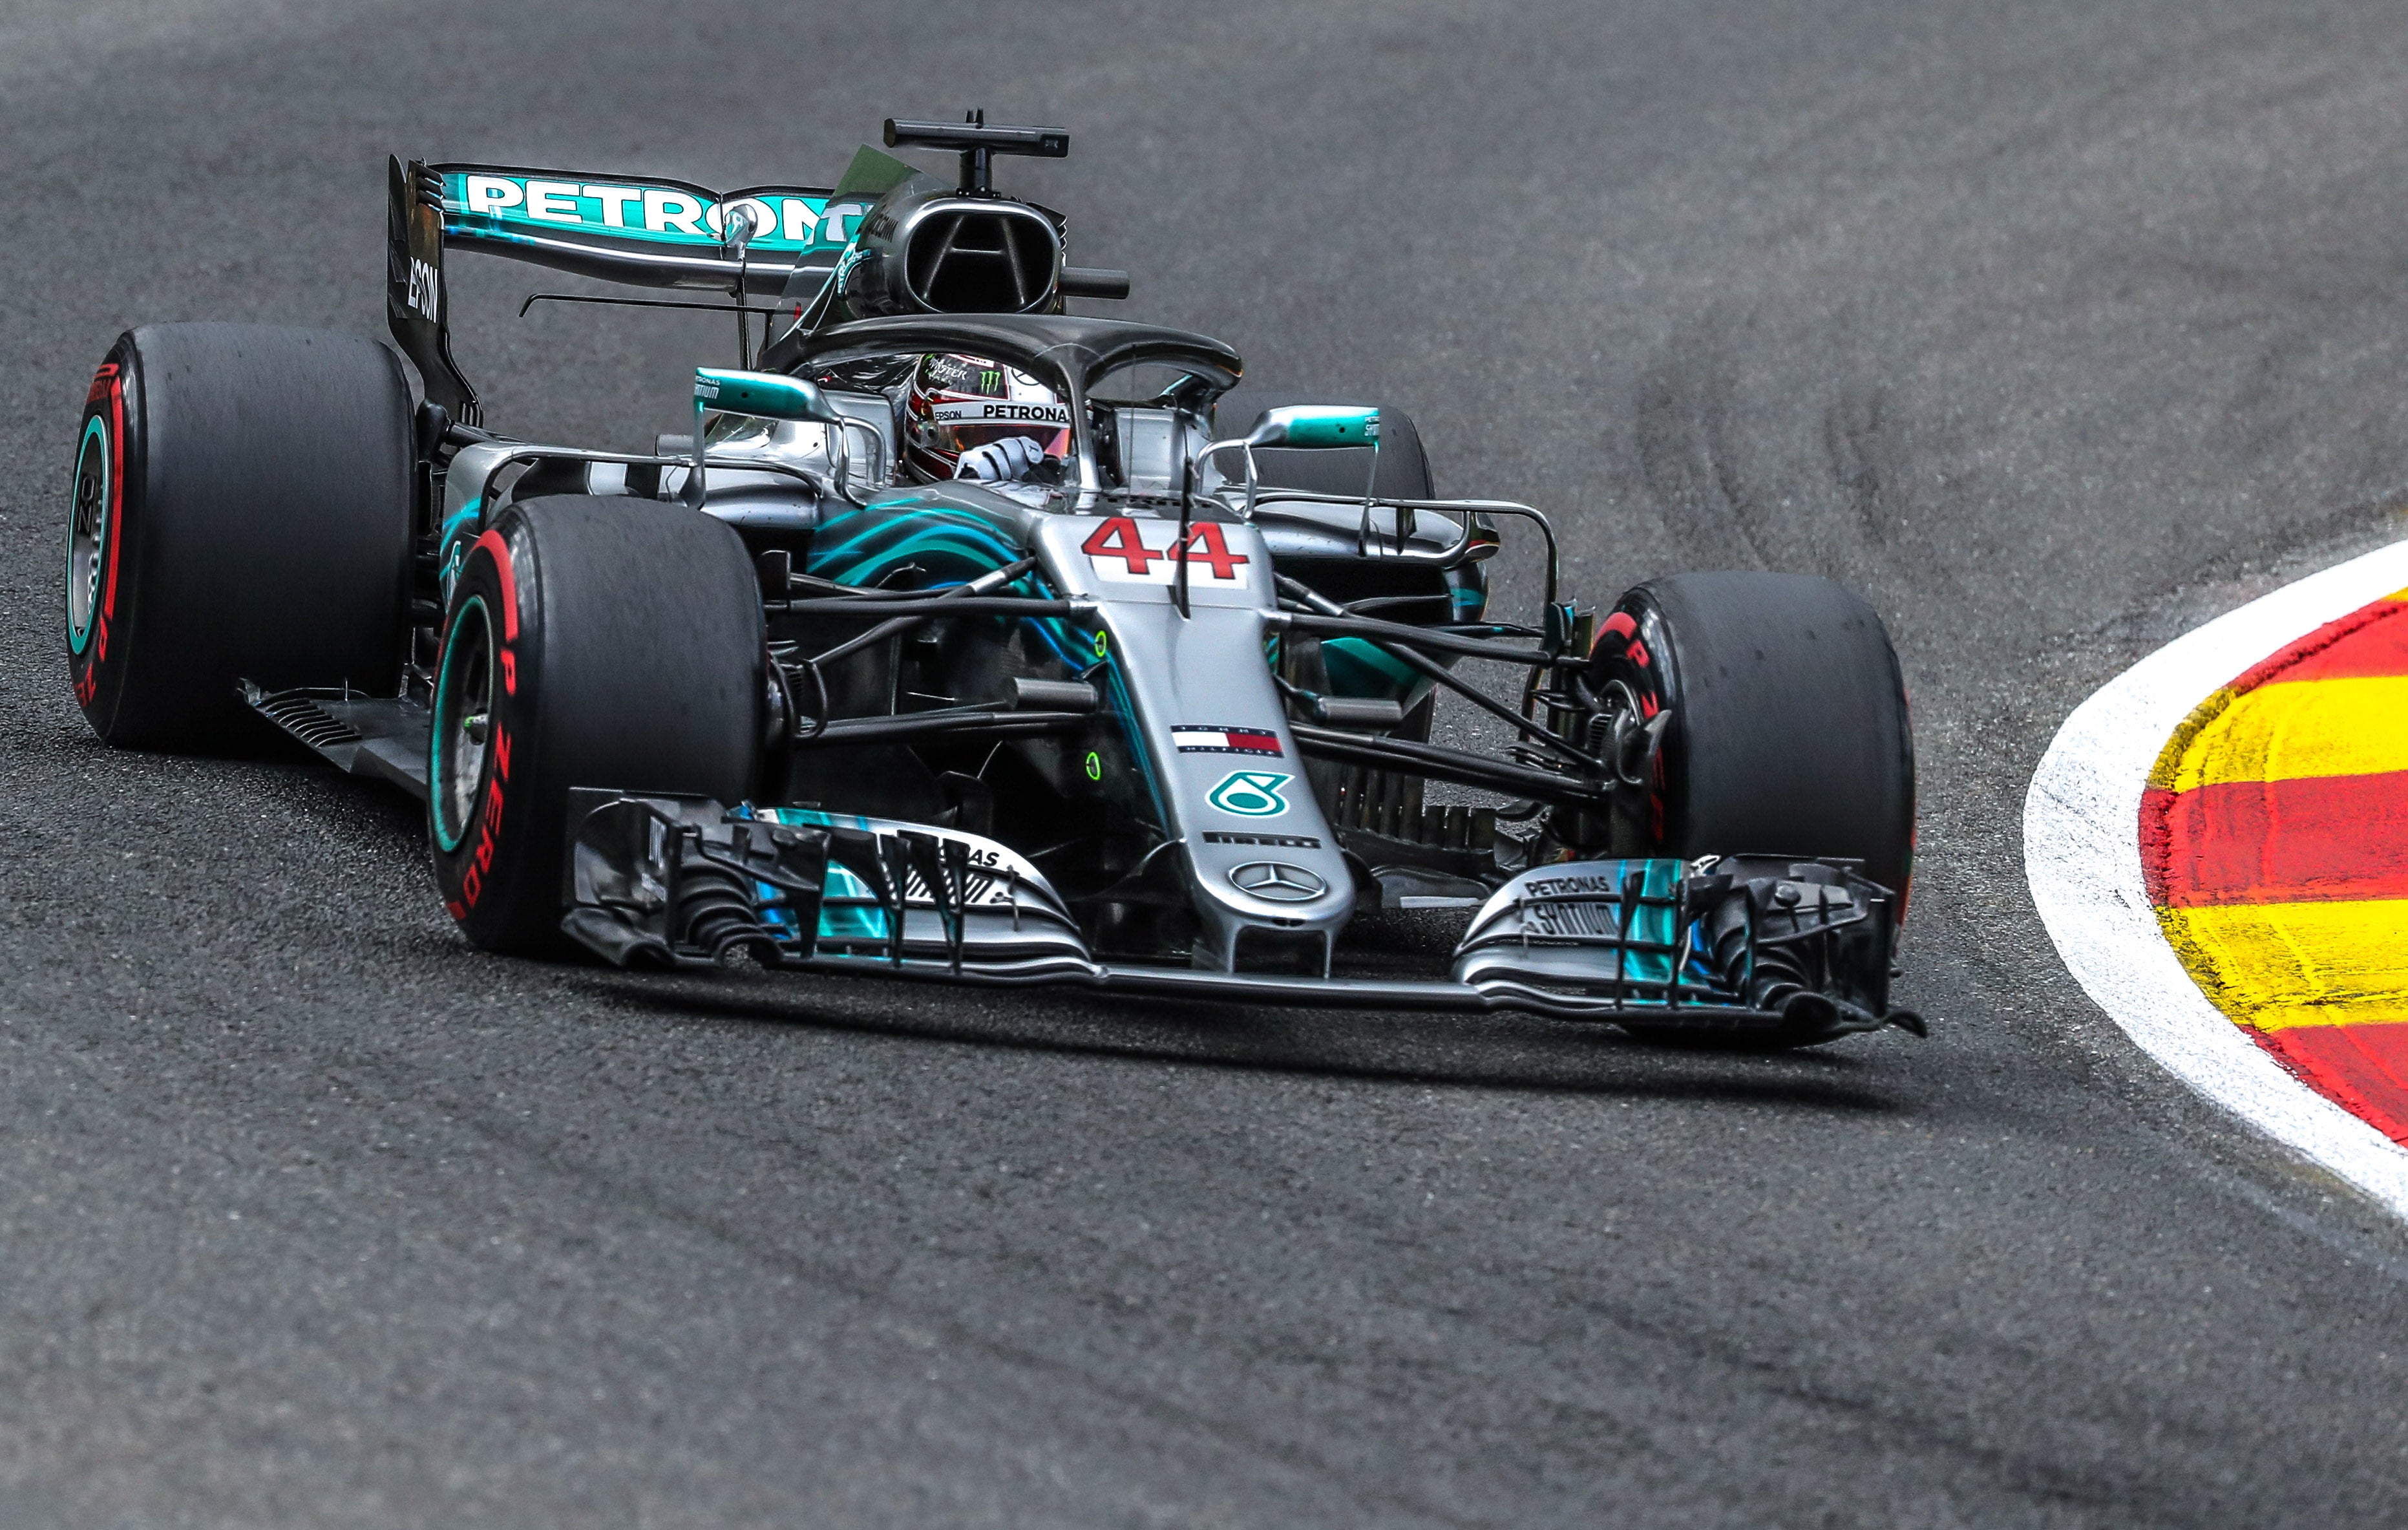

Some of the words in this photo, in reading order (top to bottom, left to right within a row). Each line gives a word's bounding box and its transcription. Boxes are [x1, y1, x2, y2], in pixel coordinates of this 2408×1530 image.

[935, 410, 962, 419] EPSON
[1081, 517, 1249, 580] 44
[1525, 875, 1610, 897] PETRONAS
